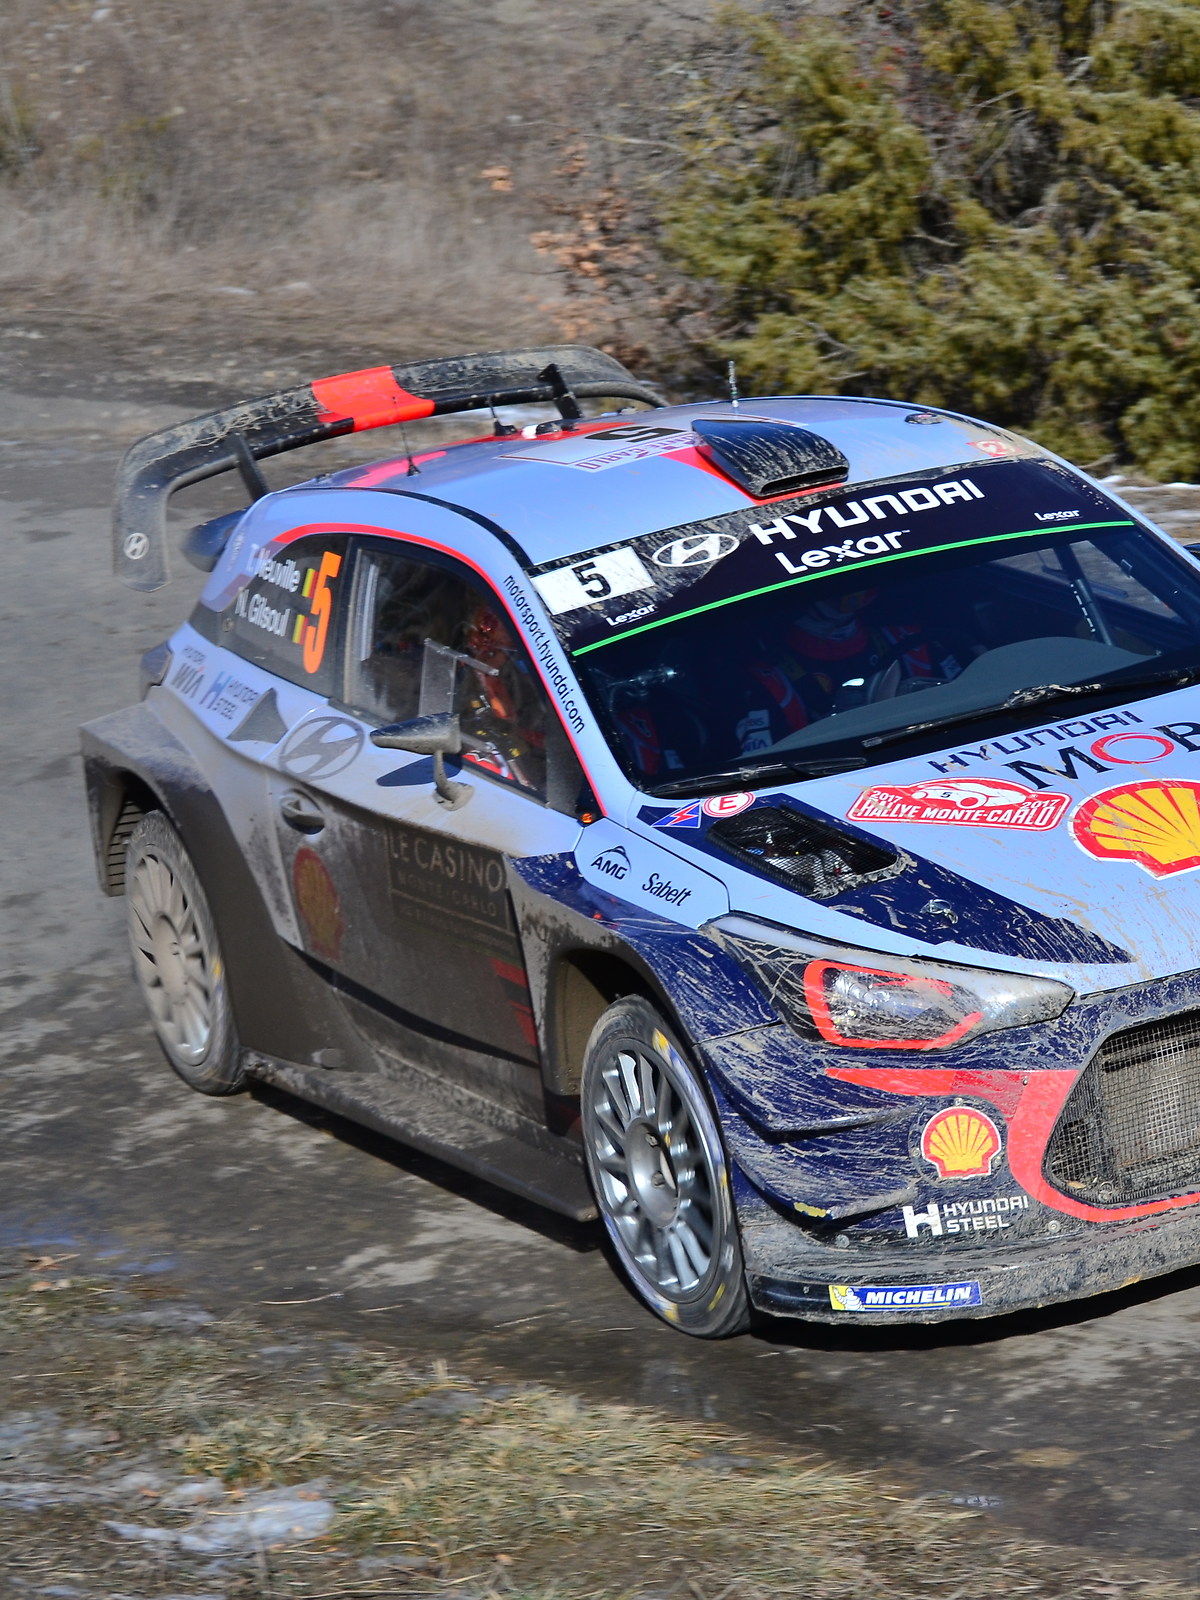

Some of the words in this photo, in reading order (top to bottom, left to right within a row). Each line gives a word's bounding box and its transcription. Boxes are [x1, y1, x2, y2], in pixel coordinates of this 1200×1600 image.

[748, 479, 985, 545] HYUNDAI
[1034, 509, 1080, 521] Lexar
[774, 530, 906, 575] Lexar
[571, 561, 612, 599] 5
[248, 593, 291, 637] Gilsoul
[303, 551, 342, 674] 5
[606, 604, 656, 627] Lexar
[503, 575, 585, 734] motorsport.hyundai.com
[927, 710, 1144, 774] HYUNDAI
[718, 795, 739, 811] E
[857, 799, 921, 818] RALLYE
[921, 806, 1058, 826] MONTE-CARLO
[870, 790, 904, 804] 2017
[1020, 800, 1060, 810] 2017
[413, 836, 504, 893] CASINO
[642, 872, 692, 907] Sabelt
[943, 1196, 1029, 1218] HYUNDAI
[946, 1214, 1010, 1234] STEEL
[866, 1286, 971, 1305] MICHELIN
